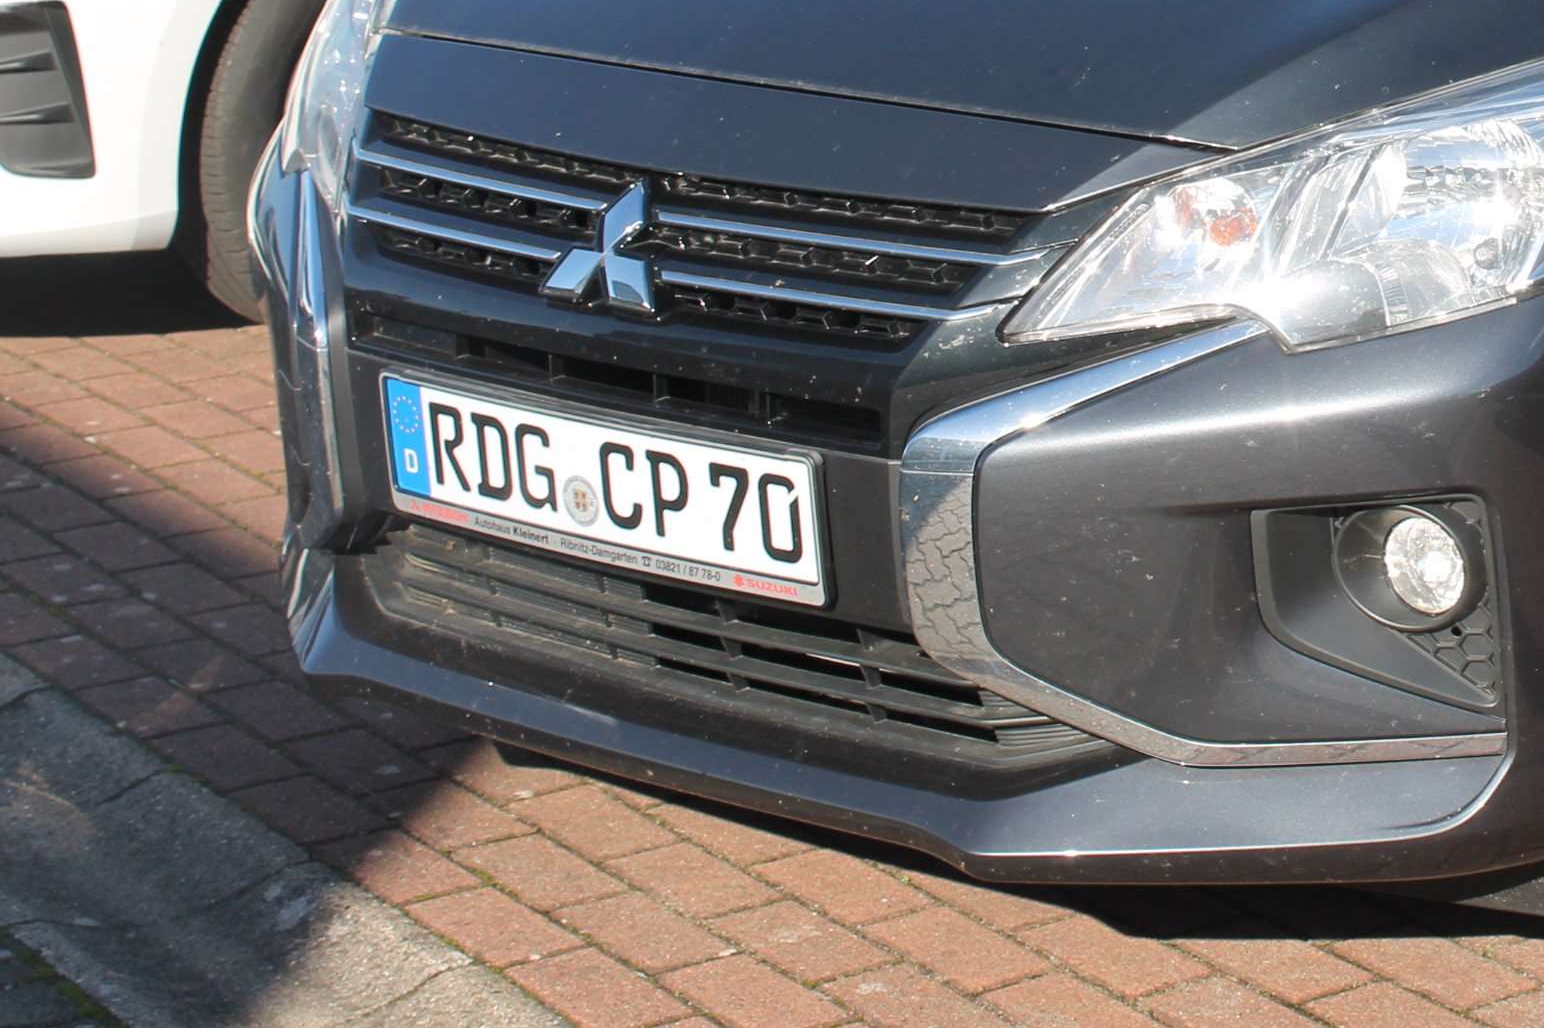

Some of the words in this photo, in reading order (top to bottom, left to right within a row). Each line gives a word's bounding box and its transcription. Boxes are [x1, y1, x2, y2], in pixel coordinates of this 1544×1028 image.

[405, 447, 419, 474] D
[428, 402, 557, 512] RDG
[599, 442, 688, 537] CP
[709, 462, 803, 564] 70
[475, 517, 511, 535] Autohaus
[512, 526, 549, 545] Kleinert
[560, 538, 638, 565] Ribnitz-Damgarten
[747, 578, 798, 597] SUZUKI
